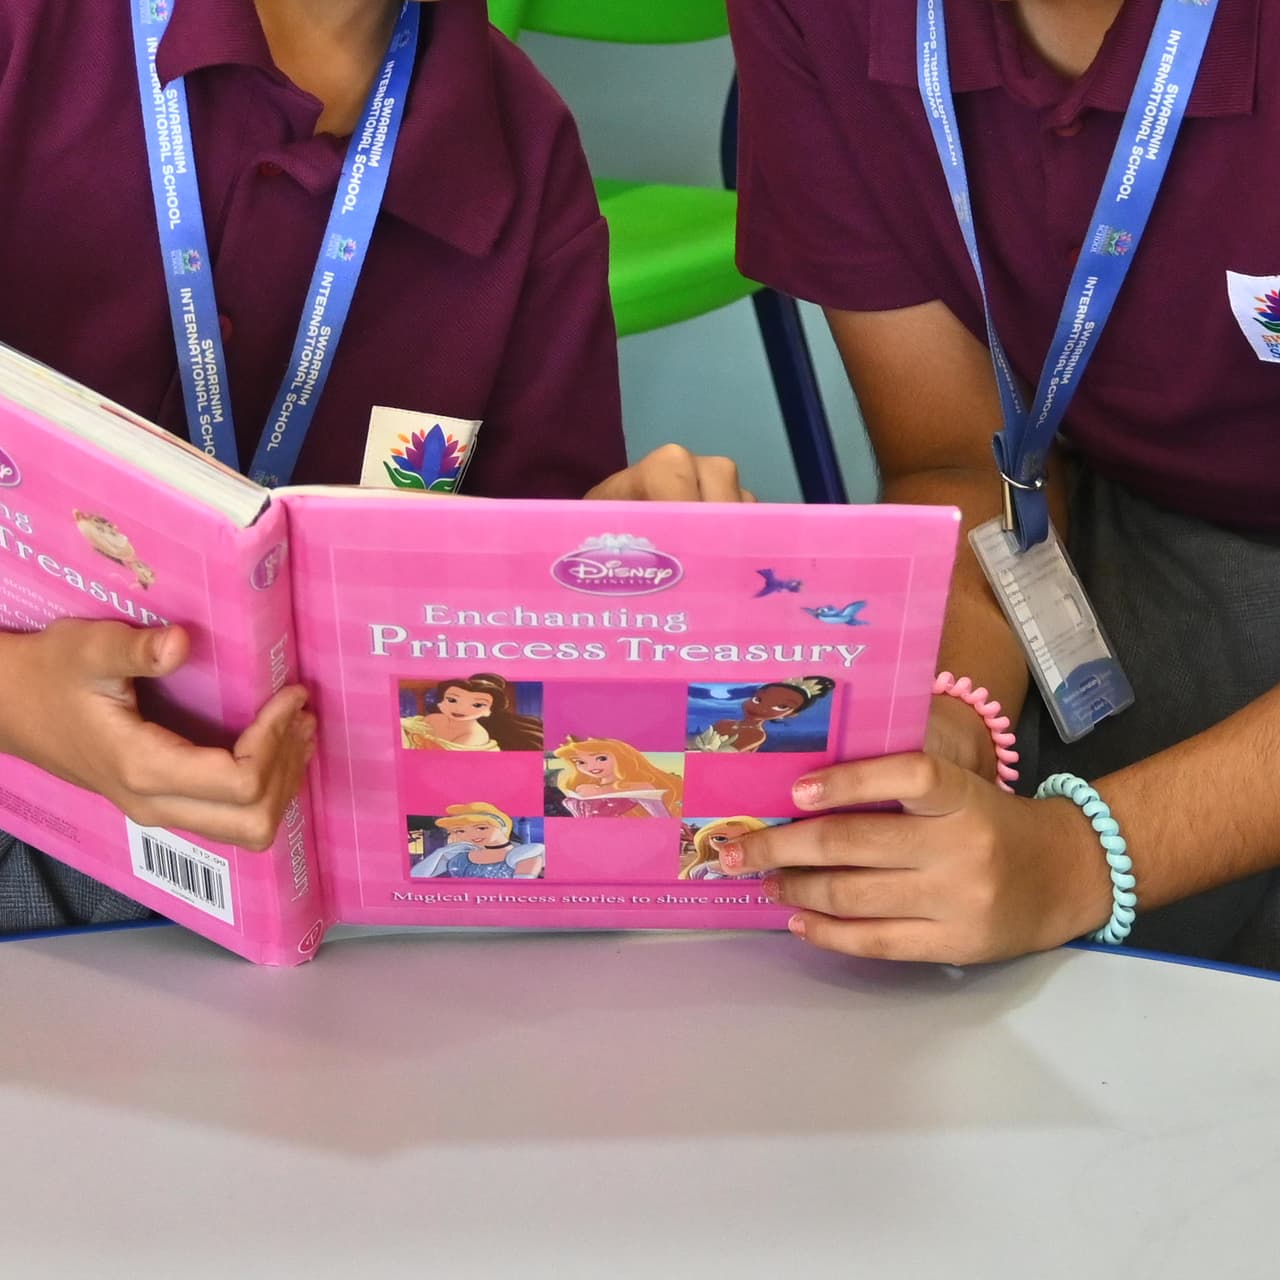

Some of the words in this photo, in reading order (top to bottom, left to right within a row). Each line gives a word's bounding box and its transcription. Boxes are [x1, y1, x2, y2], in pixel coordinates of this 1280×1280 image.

[358, 60, 395, 151] INTERNATIONAL
[923, 41, 940, 119] SWARRNIM
[931, 52, 958, 166] INTERNATIONAL
[1140, 29, 1183, 142] INTERNATIONAL
[166, 88, 187, 175] SWARRNIM
[367, 97, 395, 168] SWARRNIM
[1145, 82, 1179, 161] SWARRNIM
[163, 166, 181, 230] SCHOOL
[341, 154, 367, 215] SCHOOL
[1116, 146, 1145, 204] SCHOOL
[290, 271, 335, 389] INTERNATIONAL
[1052, 276, 1099, 375] INTERNATIONAL
[1059, 321, 1096, 385] SWARRNIM
[180, 287, 210, 411] INTERNATIONAL
[199, 414, 217, 458] SCHO
[200, 339, 224, 423] SWARRNIM
[297, 325, 331, 406] SWARRNIM
[1035, 377, 1060, 429] SCHOOL
[267, 392, 297, 452] SCHOOL
[562, 557, 673, 585] Disney
[368, 623, 608, 661] Princess
[617, 635, 867, 668] Treasury
[422, 603, 689, 634] Enchanting
[288, 818, 310, 903] Treasury
[392, 891, 470, 905] Magical
[476, 894, 557, 906] princess
[562, 893, 625, 904] stories
[631, 894, 651, 904] to
[656, 892, 709, 905] share
[714, 892, 752, 905] and
